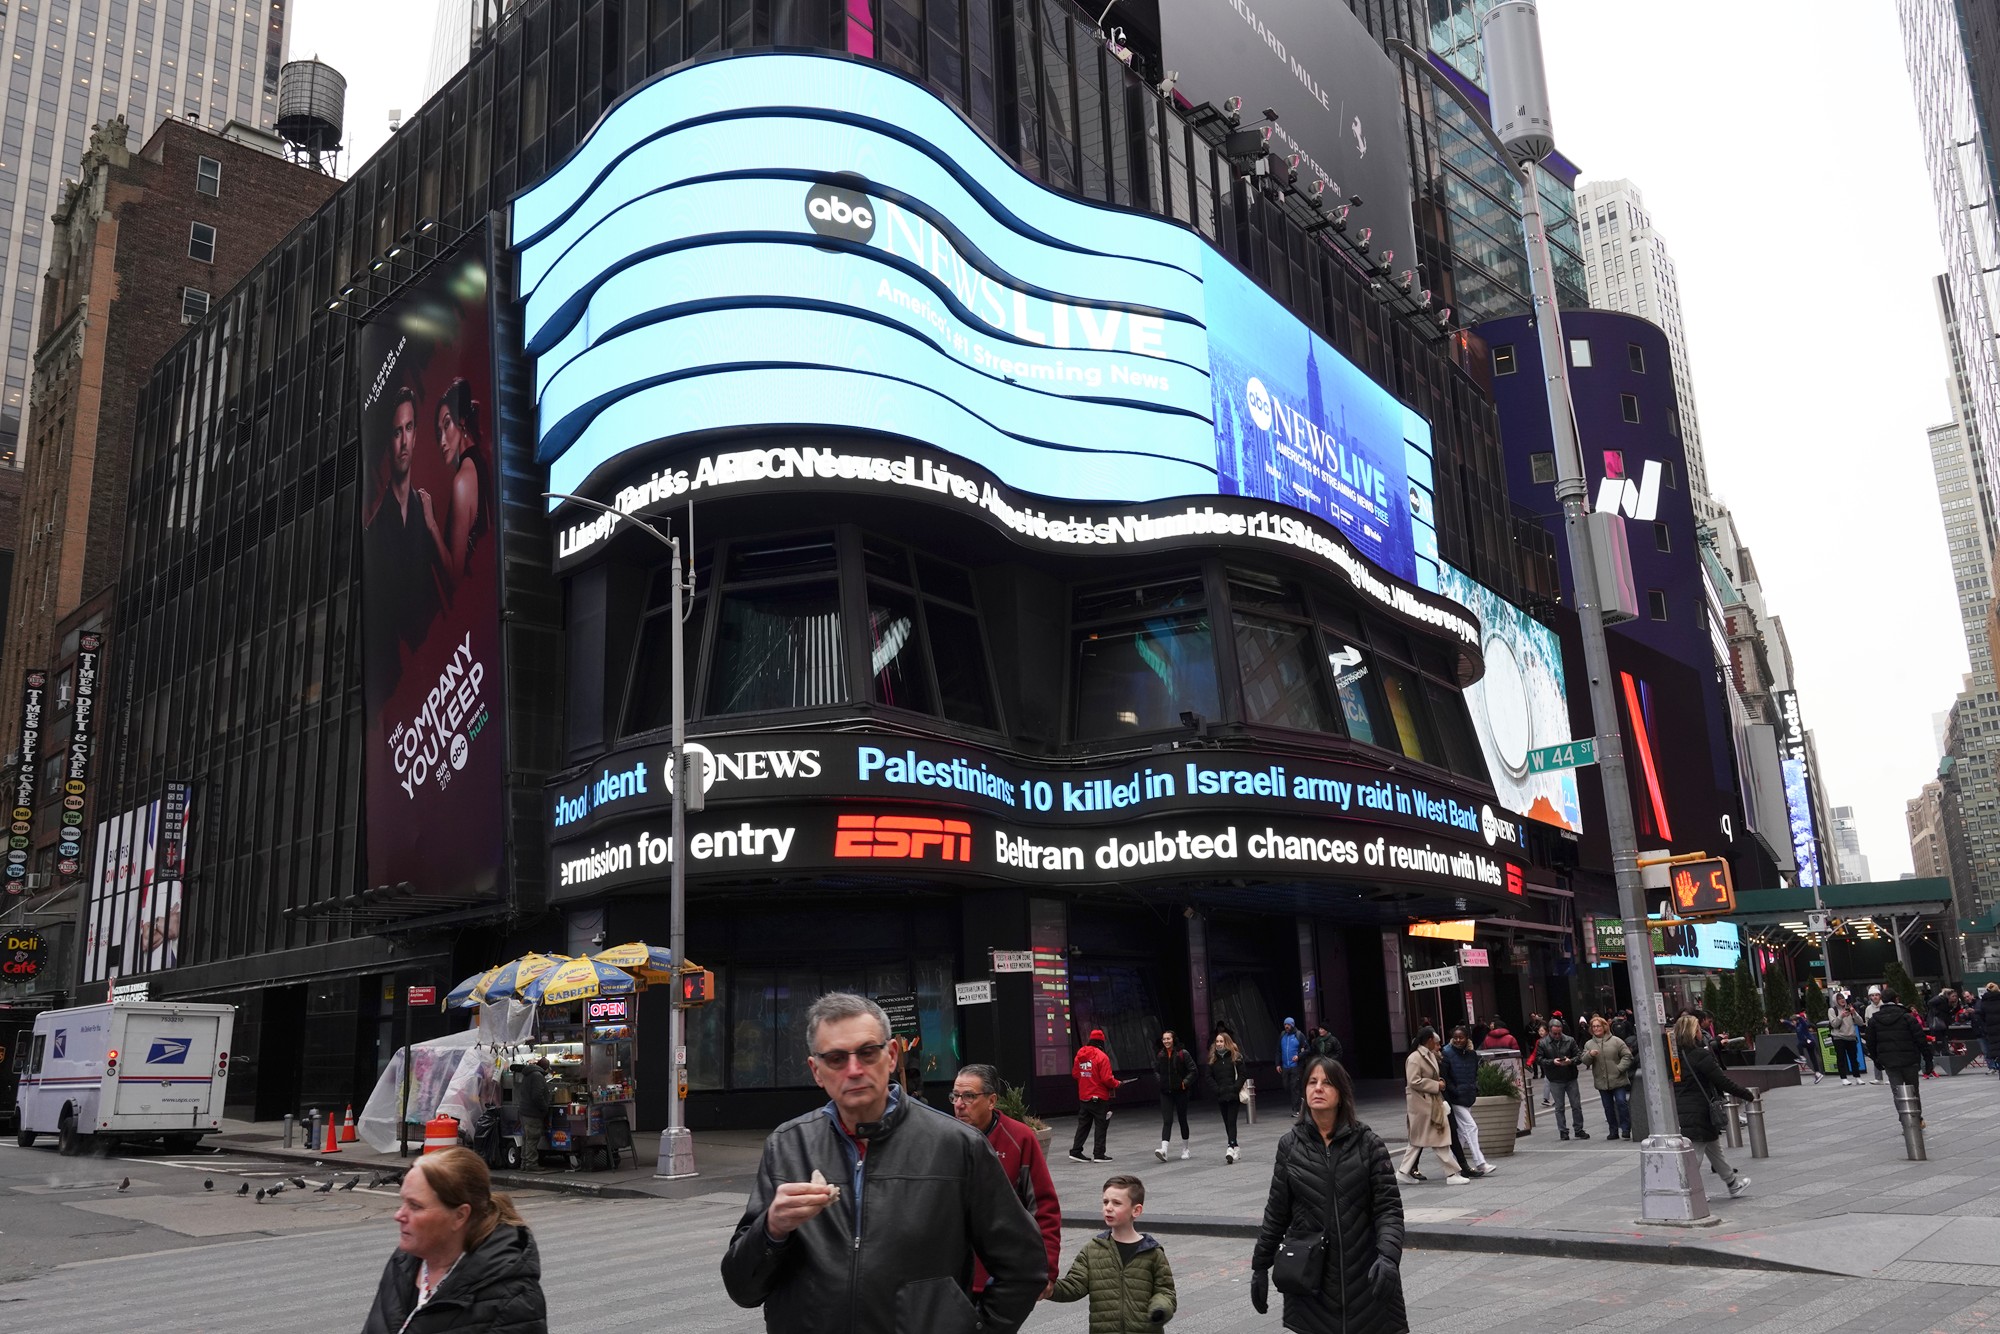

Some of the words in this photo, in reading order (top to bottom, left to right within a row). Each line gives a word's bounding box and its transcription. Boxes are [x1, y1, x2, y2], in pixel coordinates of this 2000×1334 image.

[1290, 55, 1330, 111] MILLE
[1275, 121, 1287, 143] RM
[1310, 158, 1341, 198] FERRARI
[808, 196, 873, 229] abc
[884, 199, 1006, 330] NEWS
[1012, 290, 1168, 359] LIVE
[877, 278, 952, 344] America's
[973, 343, 1102, 388] Streaming
[1110, 365, 1169, 391] News
[373, 378, 386, 402] LOVE
[386, 357, 396, 379] AND
[396, 336, 406, 357] LIES
[377, 361, 388, 384] FAIR
[1271, 395, 1339, 473] NEWS
[1338, 443, 1388, 508] LIVE
[1321, 470, 1357, 502] STREAMING
[1356, 493, 1374, 514] NEWS
[1374, 505, 1389, 524] FREE
[79, 652, 96, 695] TIMES
[26, 689, 43, 729] TIMES
[75, 697, 91, 731] DELI
[394, 630, 473, 774] COMPANY
[74, 733, 88, 742] &
[388, 721, 404, 749] THE
[401, 733, 439, 800] YOU
[436, 662, 484, 749] KEEP
[468, 711, 489, 741] hulu
[23, 730, 38, 762] DELI
[69, 743, 88, 779] CAFE
[452, 740, 466, 764] abc
[1531, 751, 1544, 771] W
[1552, 745, 1575, 766] 44
[1581, 742, 1591, 753] ST
[435, 760, 448, 781] SUN
[715, 749, 821, 782] NEWS
[17, 774, 34, 806] CAFE
[858, 747, 1015, 806] Palestinians:
[1020, 780, 1053, 812] 10
[1063, 772, 1142, 812] killed
[1145, 768, 1175, 800] in
[1187, 763, 1286, 798] Israeli
[1292, 775, 1352, 812] army
[1357, 780, 1393, 811] raid
[1396, 784, 1412, 812] in
[1412, 789, 1447, 824] West
[1449, 799, 1479, 833] Bank
[690, 822, 795, 863] entry
[834, 815, 972, 862] ESPN
[1494, 816, 1516, 843] NEWS
[120, 862, 137, 879] OPN
[995, 830, 1084, 871] Beltran
[1095, 826, 1238, 869] doubted
[1247, 830, 1358, 864] chances
[1364, 834, 1385, 867] of
[1390, 843, 1449, 876] reunion
[1450, 849, 1476, 881] with
[1476, 855, 1502, 886] Mets
[1710, 871, 1727, 903] 5
[8, 937, 38, 950] Deli
[3, 961, 37, 973] Café
[547, 983, 598, 1001] SABRETT
[590, 1002, 625, 1016] OPEN
